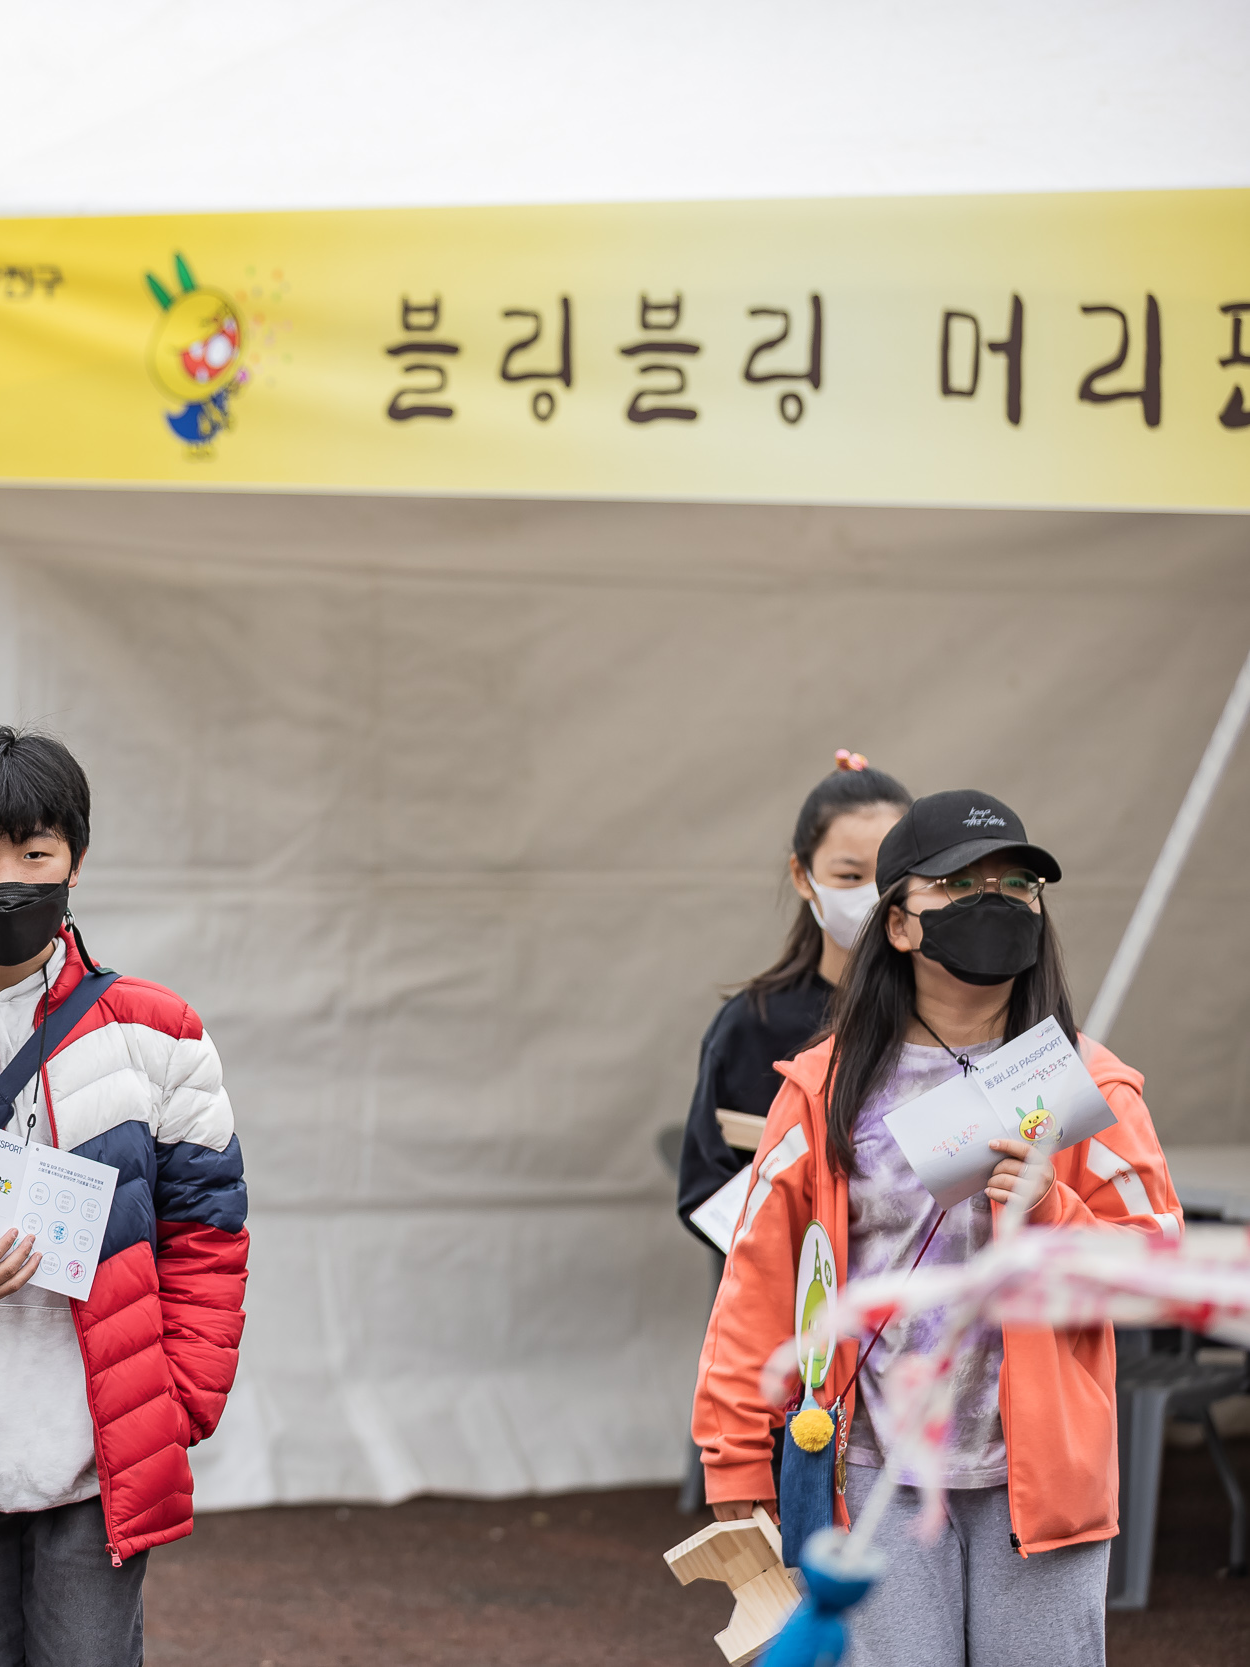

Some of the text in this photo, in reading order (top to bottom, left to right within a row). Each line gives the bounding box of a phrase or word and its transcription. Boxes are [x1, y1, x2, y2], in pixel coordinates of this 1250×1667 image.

[385, 290, 826, 426] 블링블링
[984, 1063, 1019, 1090] 동화나라
[1018, 1035, 1063, 1069] PASSPORT
